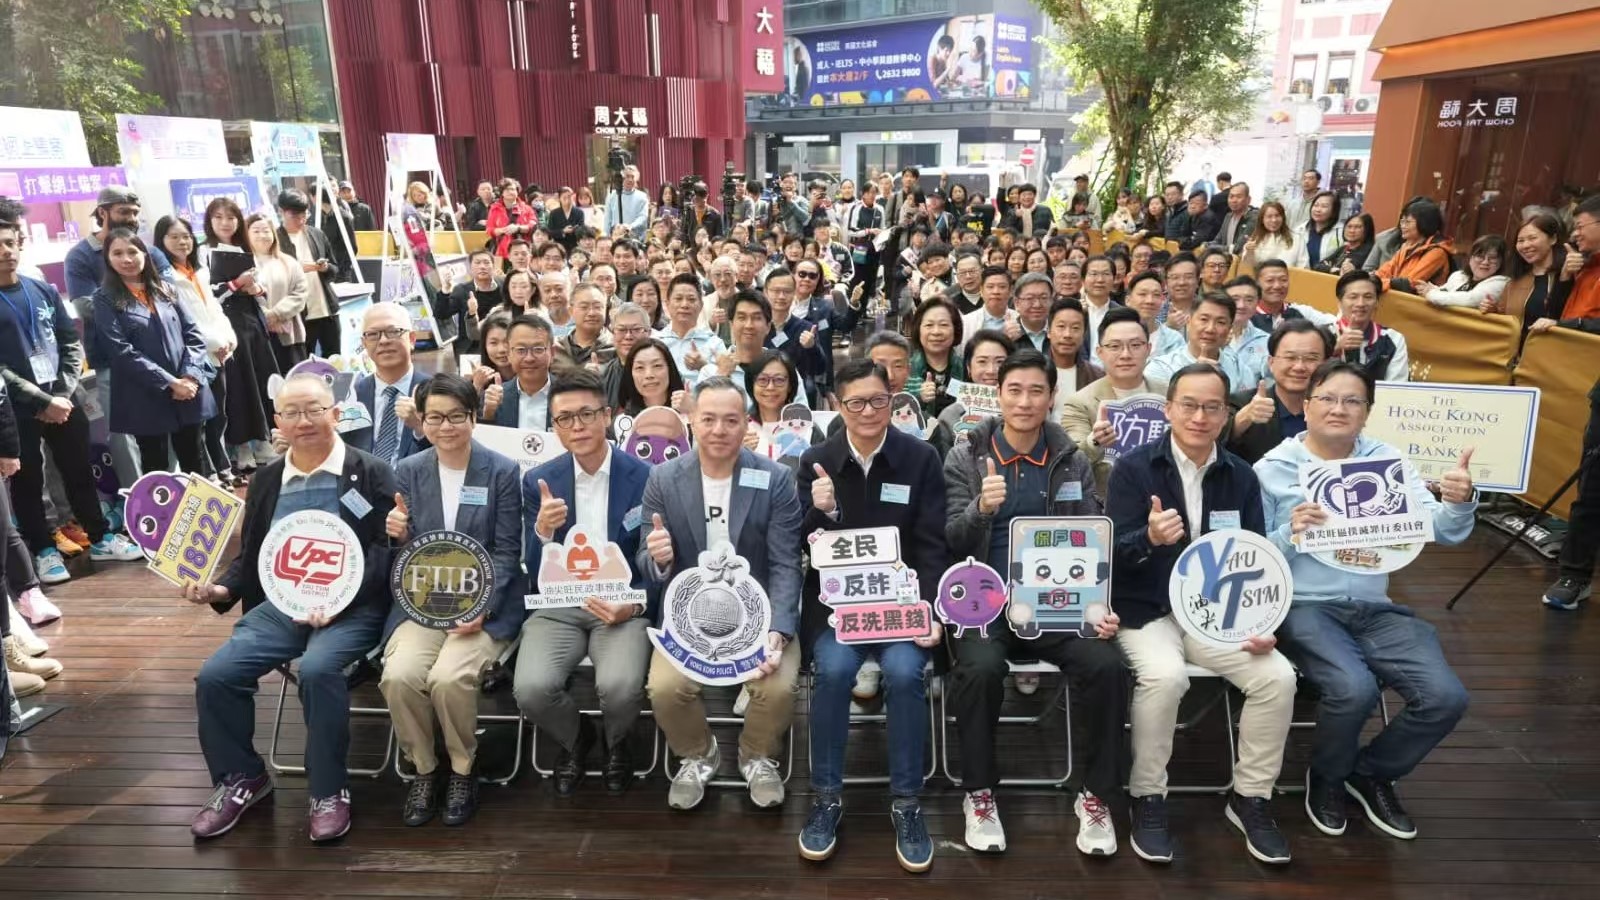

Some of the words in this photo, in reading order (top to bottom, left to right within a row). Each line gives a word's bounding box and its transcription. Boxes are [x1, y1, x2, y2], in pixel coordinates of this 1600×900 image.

[594, 106, 648, 126] 周大福
[23, 172, 101, 196] 打擊網上騙案
[1432, 395, 1457, 406] THE
[1387, 406, 1440, 420] HONG
[1446, 409, 1499, 424] KONG
[1396, 422, 1487, 436] ASSOCIATION
[1431, 435, 1447, 443] OF
[1408, 443, 1465, 458] BANK
[177, 497, 233, 581] 18222
[1305, 520, 1424, 541] 油尖旺區撲滅罪行委員會
[291, 541, 341, 568] JPC
[831, 534, 878, 560] 全民
[407, 564, 479, 594] FIIB
[544, 582, 626, 596] 油尖旺民政事務處
[844, 572, 890, 597] 反詐
[528, 597, 543, 606] Yau
[544, 595, 564, 605] Tsim
[621, 591, 645, 601] Office
[840, 608, 926, 634] 反洗黑錢
[688, 660, 703, 671] HONG
[703, 665, 716, 675] KONG
[716, 666, 734, 675] POLICE
